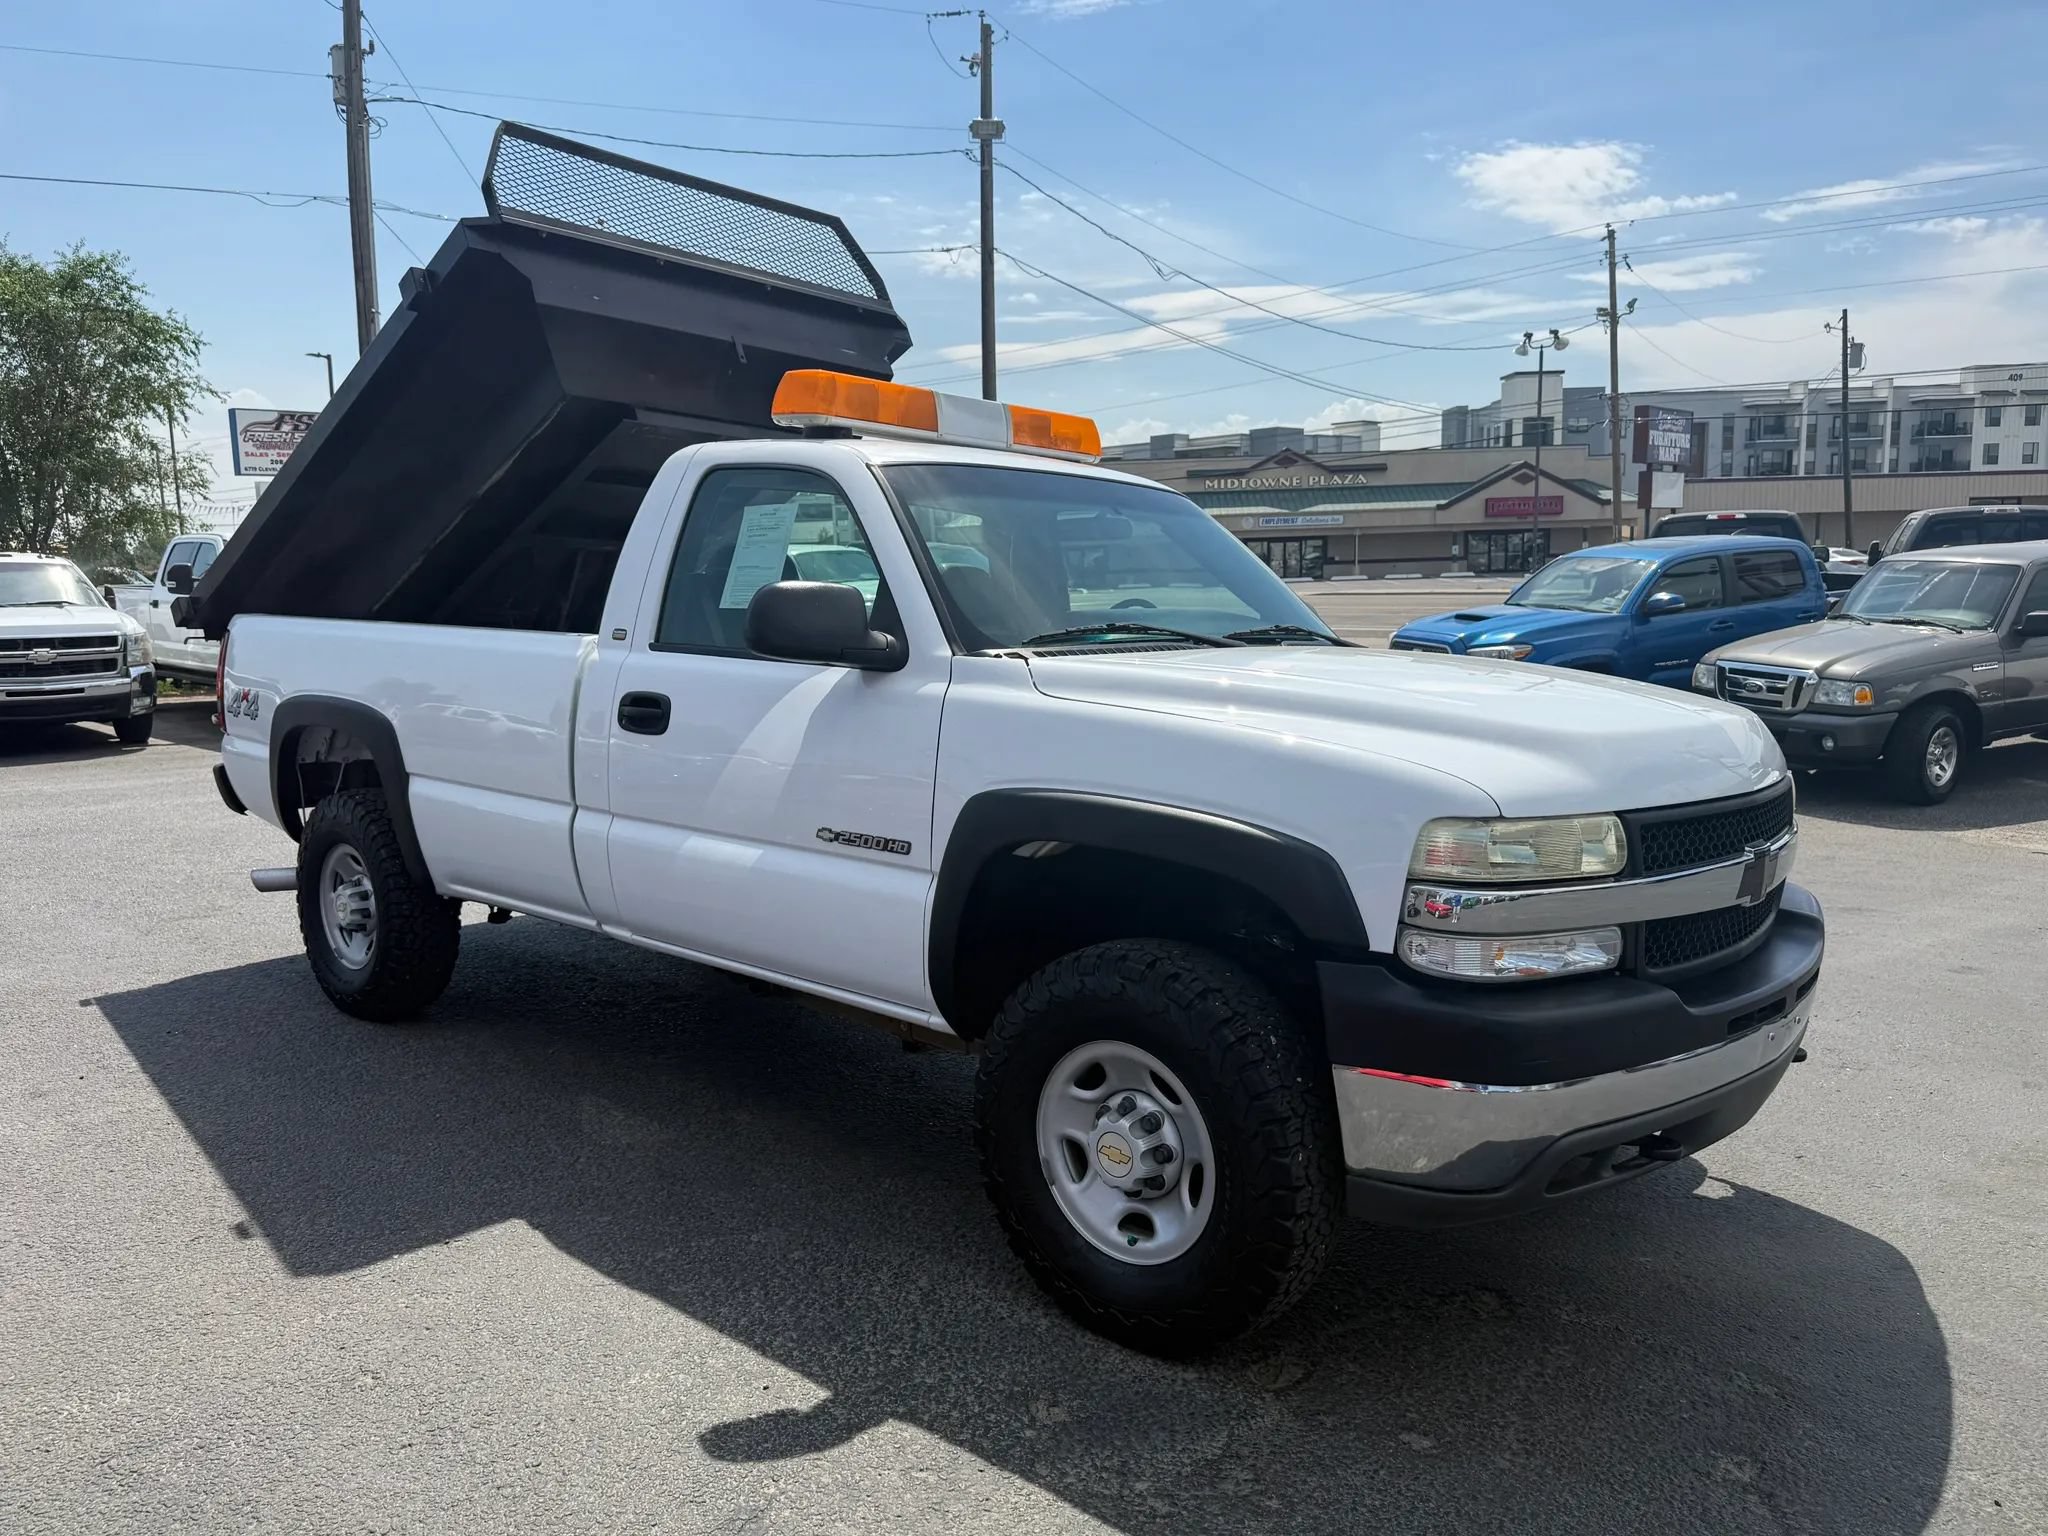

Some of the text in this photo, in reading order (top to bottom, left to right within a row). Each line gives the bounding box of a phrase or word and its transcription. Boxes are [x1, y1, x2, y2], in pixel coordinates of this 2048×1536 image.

[243, 431, 292, 443] FRESH
[1649, 430, 1690, 448] FURNITURE
[1658, 446, 1680, 462] MART
[1204, 473, 1368, 490] MIDTOWNE PLAZA
[838, 831, 911, 855] 2500 HD
